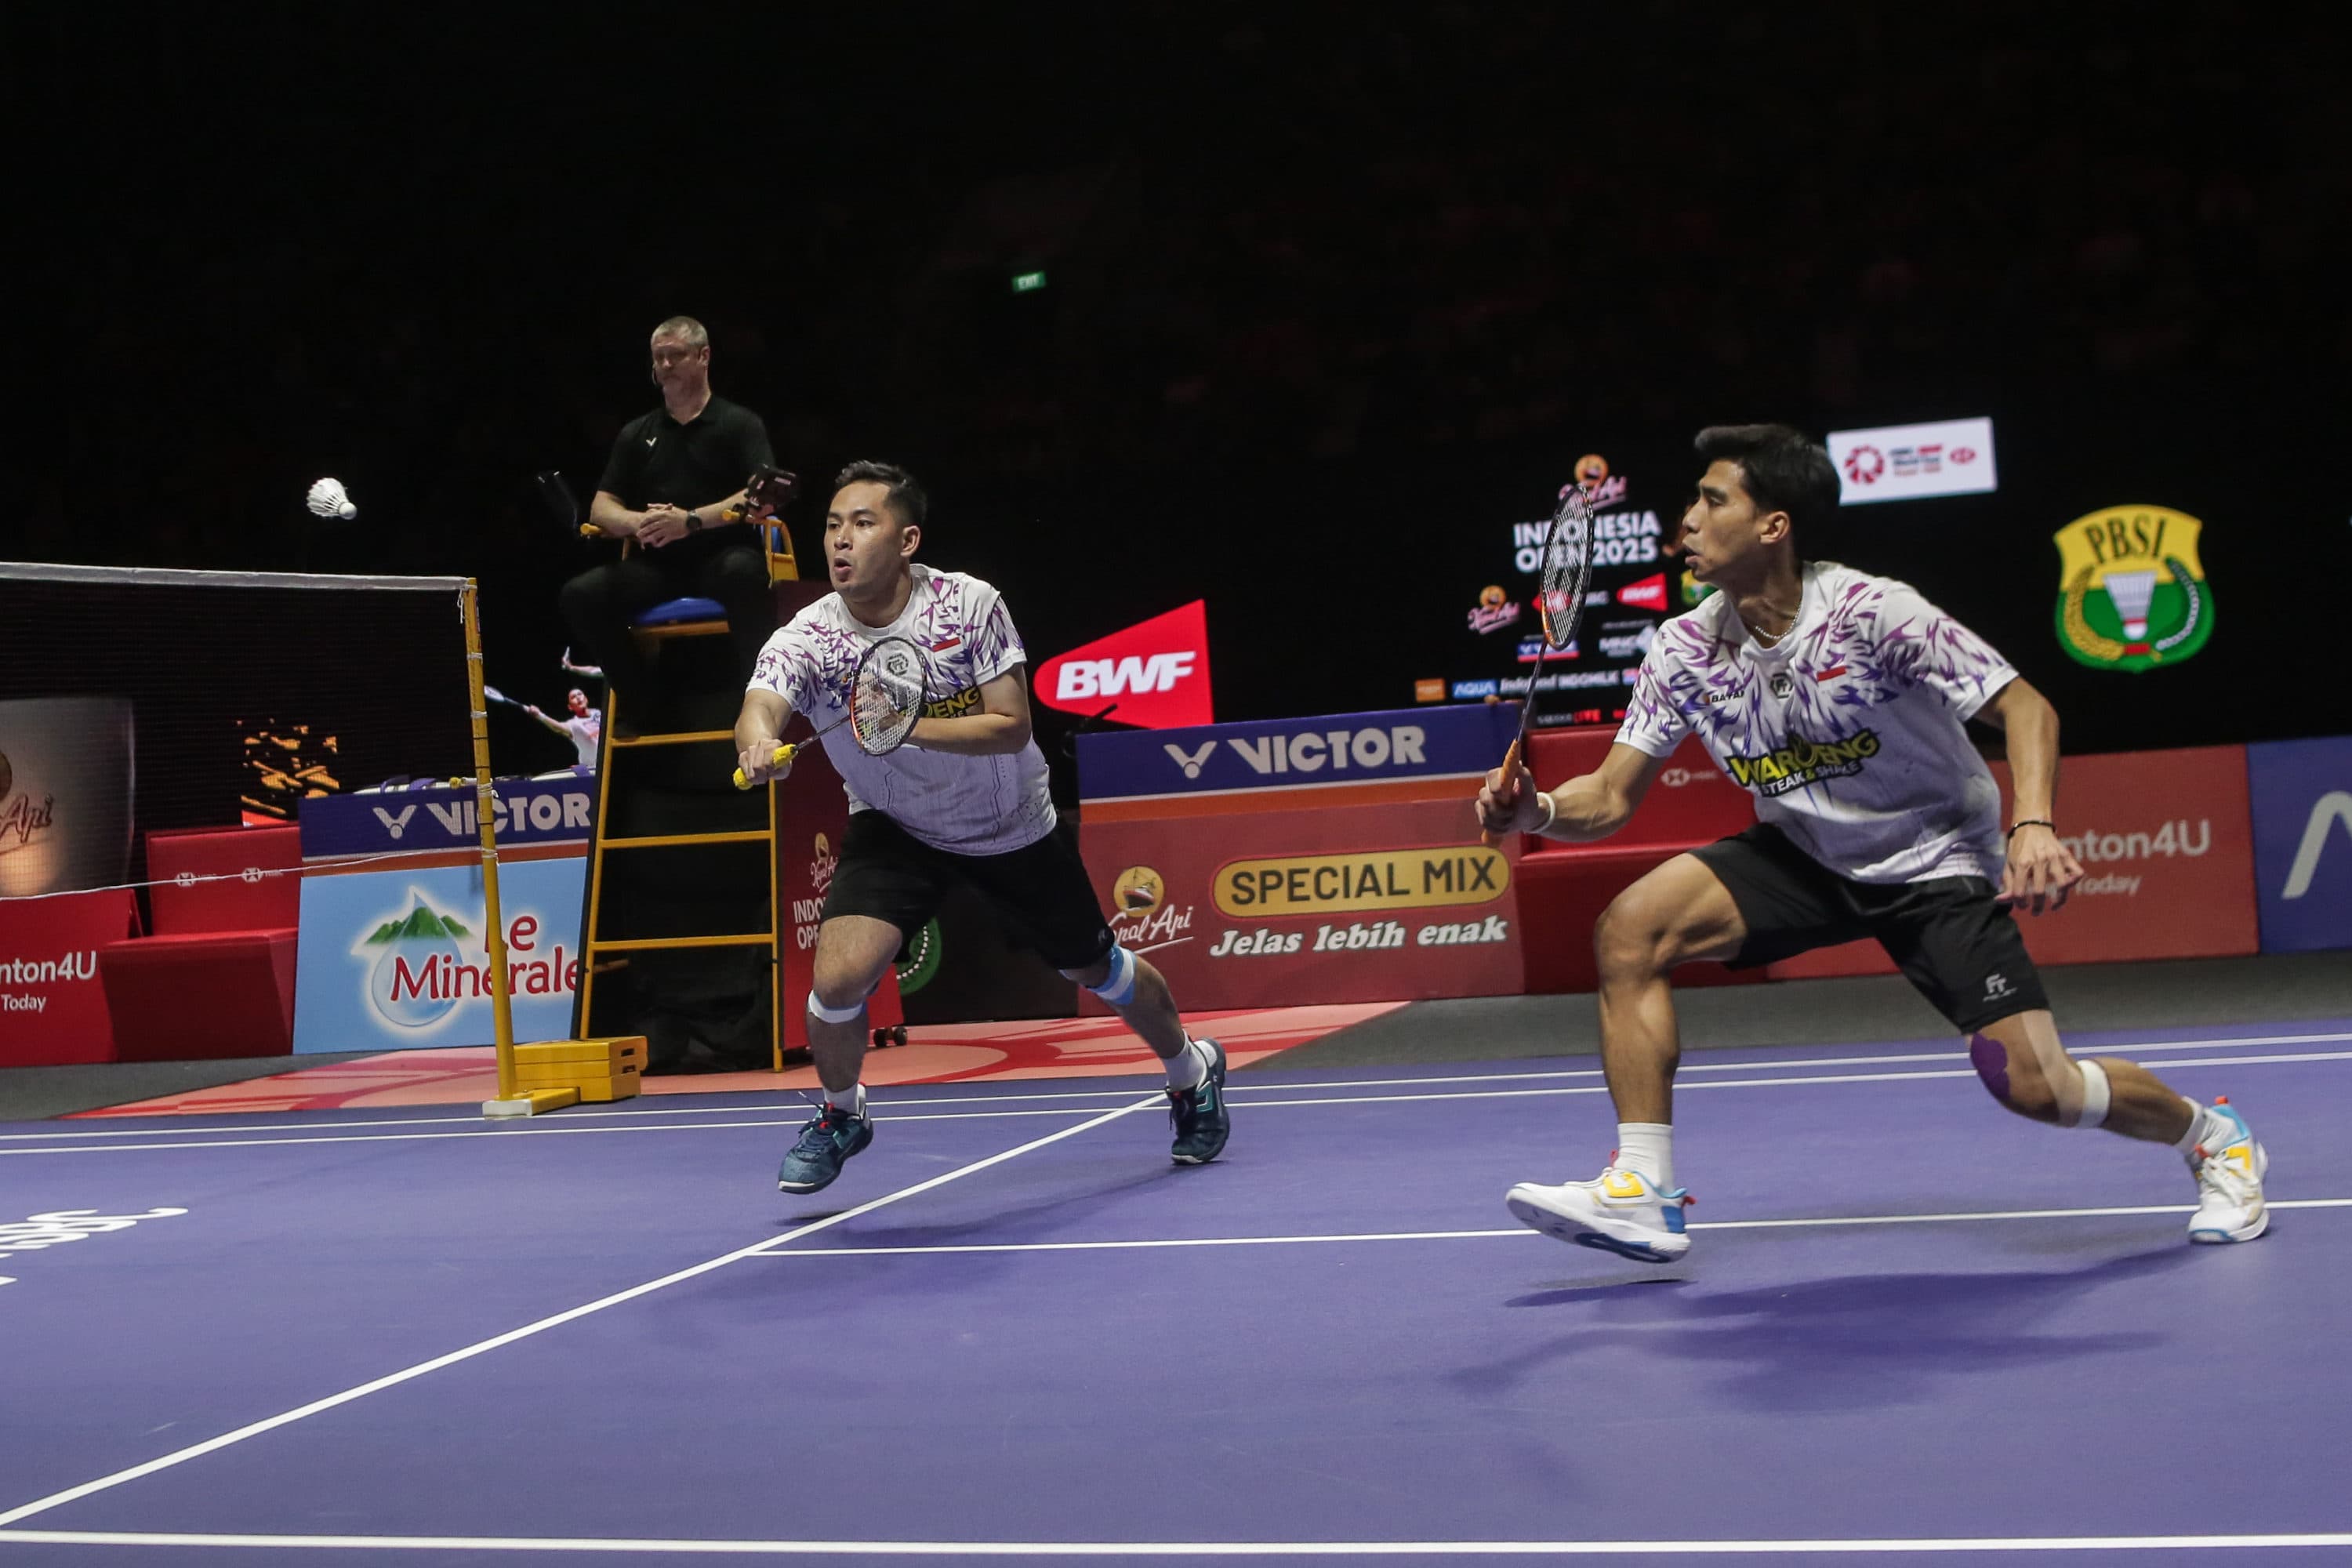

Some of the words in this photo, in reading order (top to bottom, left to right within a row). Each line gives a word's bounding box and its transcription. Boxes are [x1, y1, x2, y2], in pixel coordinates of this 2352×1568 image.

[1593, 536, 1658, 566] 2025
[2085, 514, 2166, 564] PBSI
[1057, 651, 1196, 700] BWF
[1454, 681, 1494, 697] AQUA
[1228, 725, 1425, 775] VICTOR
[1730, 731, 1878, 784] WAROENG
[426, 793, 590, 835] VICTOR
[1231, 862, 1410, 905] SPECIAL
[1423, 855, 1497, 894] MIX
[793, 897, 826, 924] INDO
[1148, 904, 1193, 940] Api
[797, 924, 820, 949] OPE
[1210, 928, 1301, 958] Jelas
[1312, 921, 1406, 951] lebih
[1417, 914, 1508, 945] enak
[0, 950, 96, 985] nton4U
[1, 993, 47, 1014] Today
